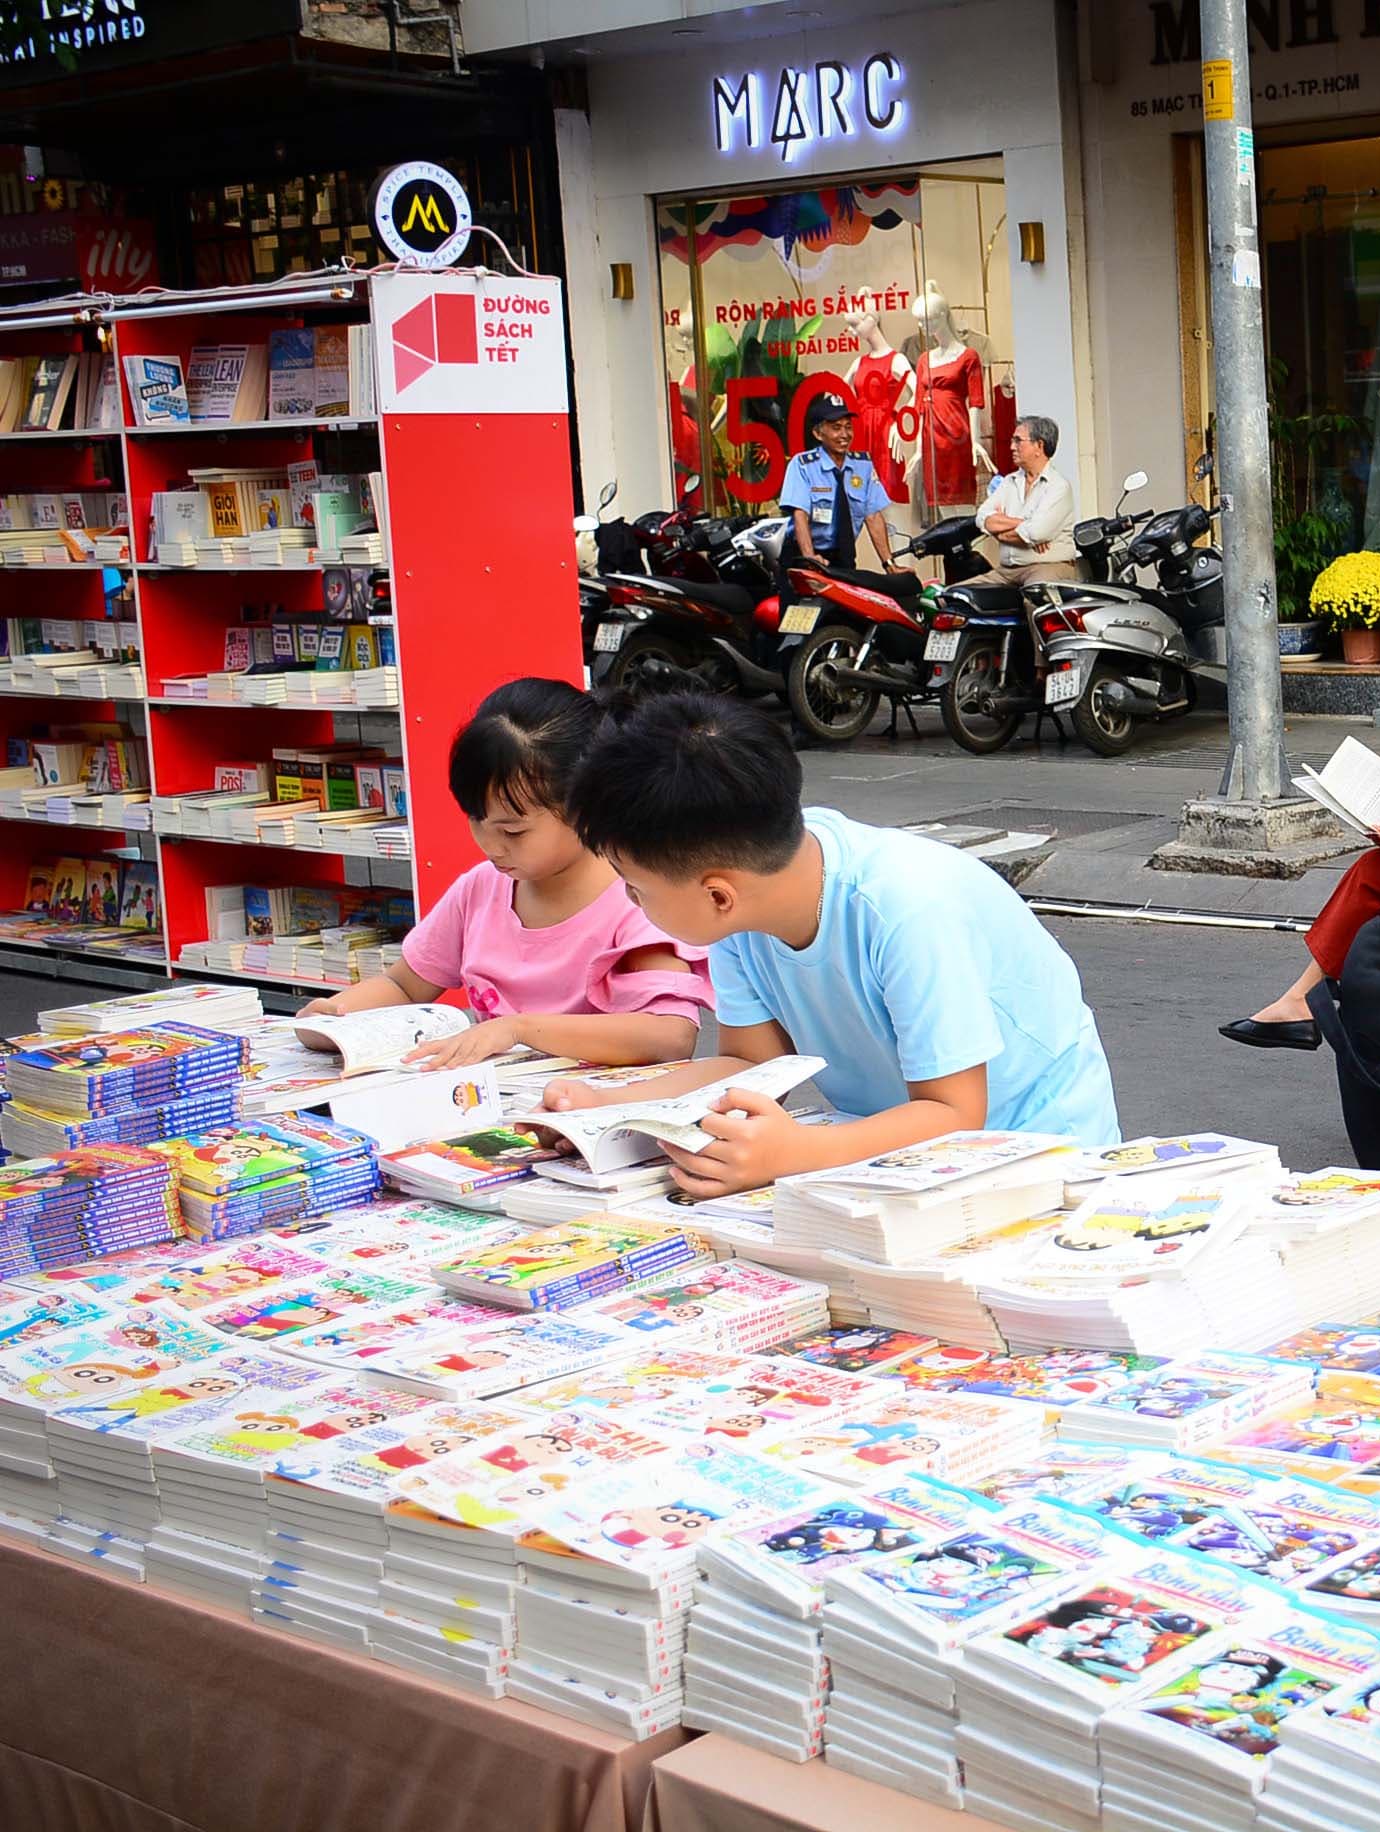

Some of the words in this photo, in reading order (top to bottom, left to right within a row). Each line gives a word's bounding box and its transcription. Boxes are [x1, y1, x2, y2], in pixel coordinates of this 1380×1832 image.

[713, 52, 903, 163] MARC
[1130, 101, 1148, 117] 85
[87, 229, 153, 288] illy
[483, 294, 551, 315] ĐƯỜNG
[716, 300, 756, 328] RỘN
[763, 295, 817, 321] RÀNG
[822, 284, 866, 316] SẮM
[868, 282, 910, 312] TẾT
[484, 318, 534, 339] SÁCH
[485, 340, 520, 363] TẾT
[796, 337, 823, 356] ĐÃI
[826, 329, 861, 354] ĐẾN
[214, 359, 243, 382] LEAN
